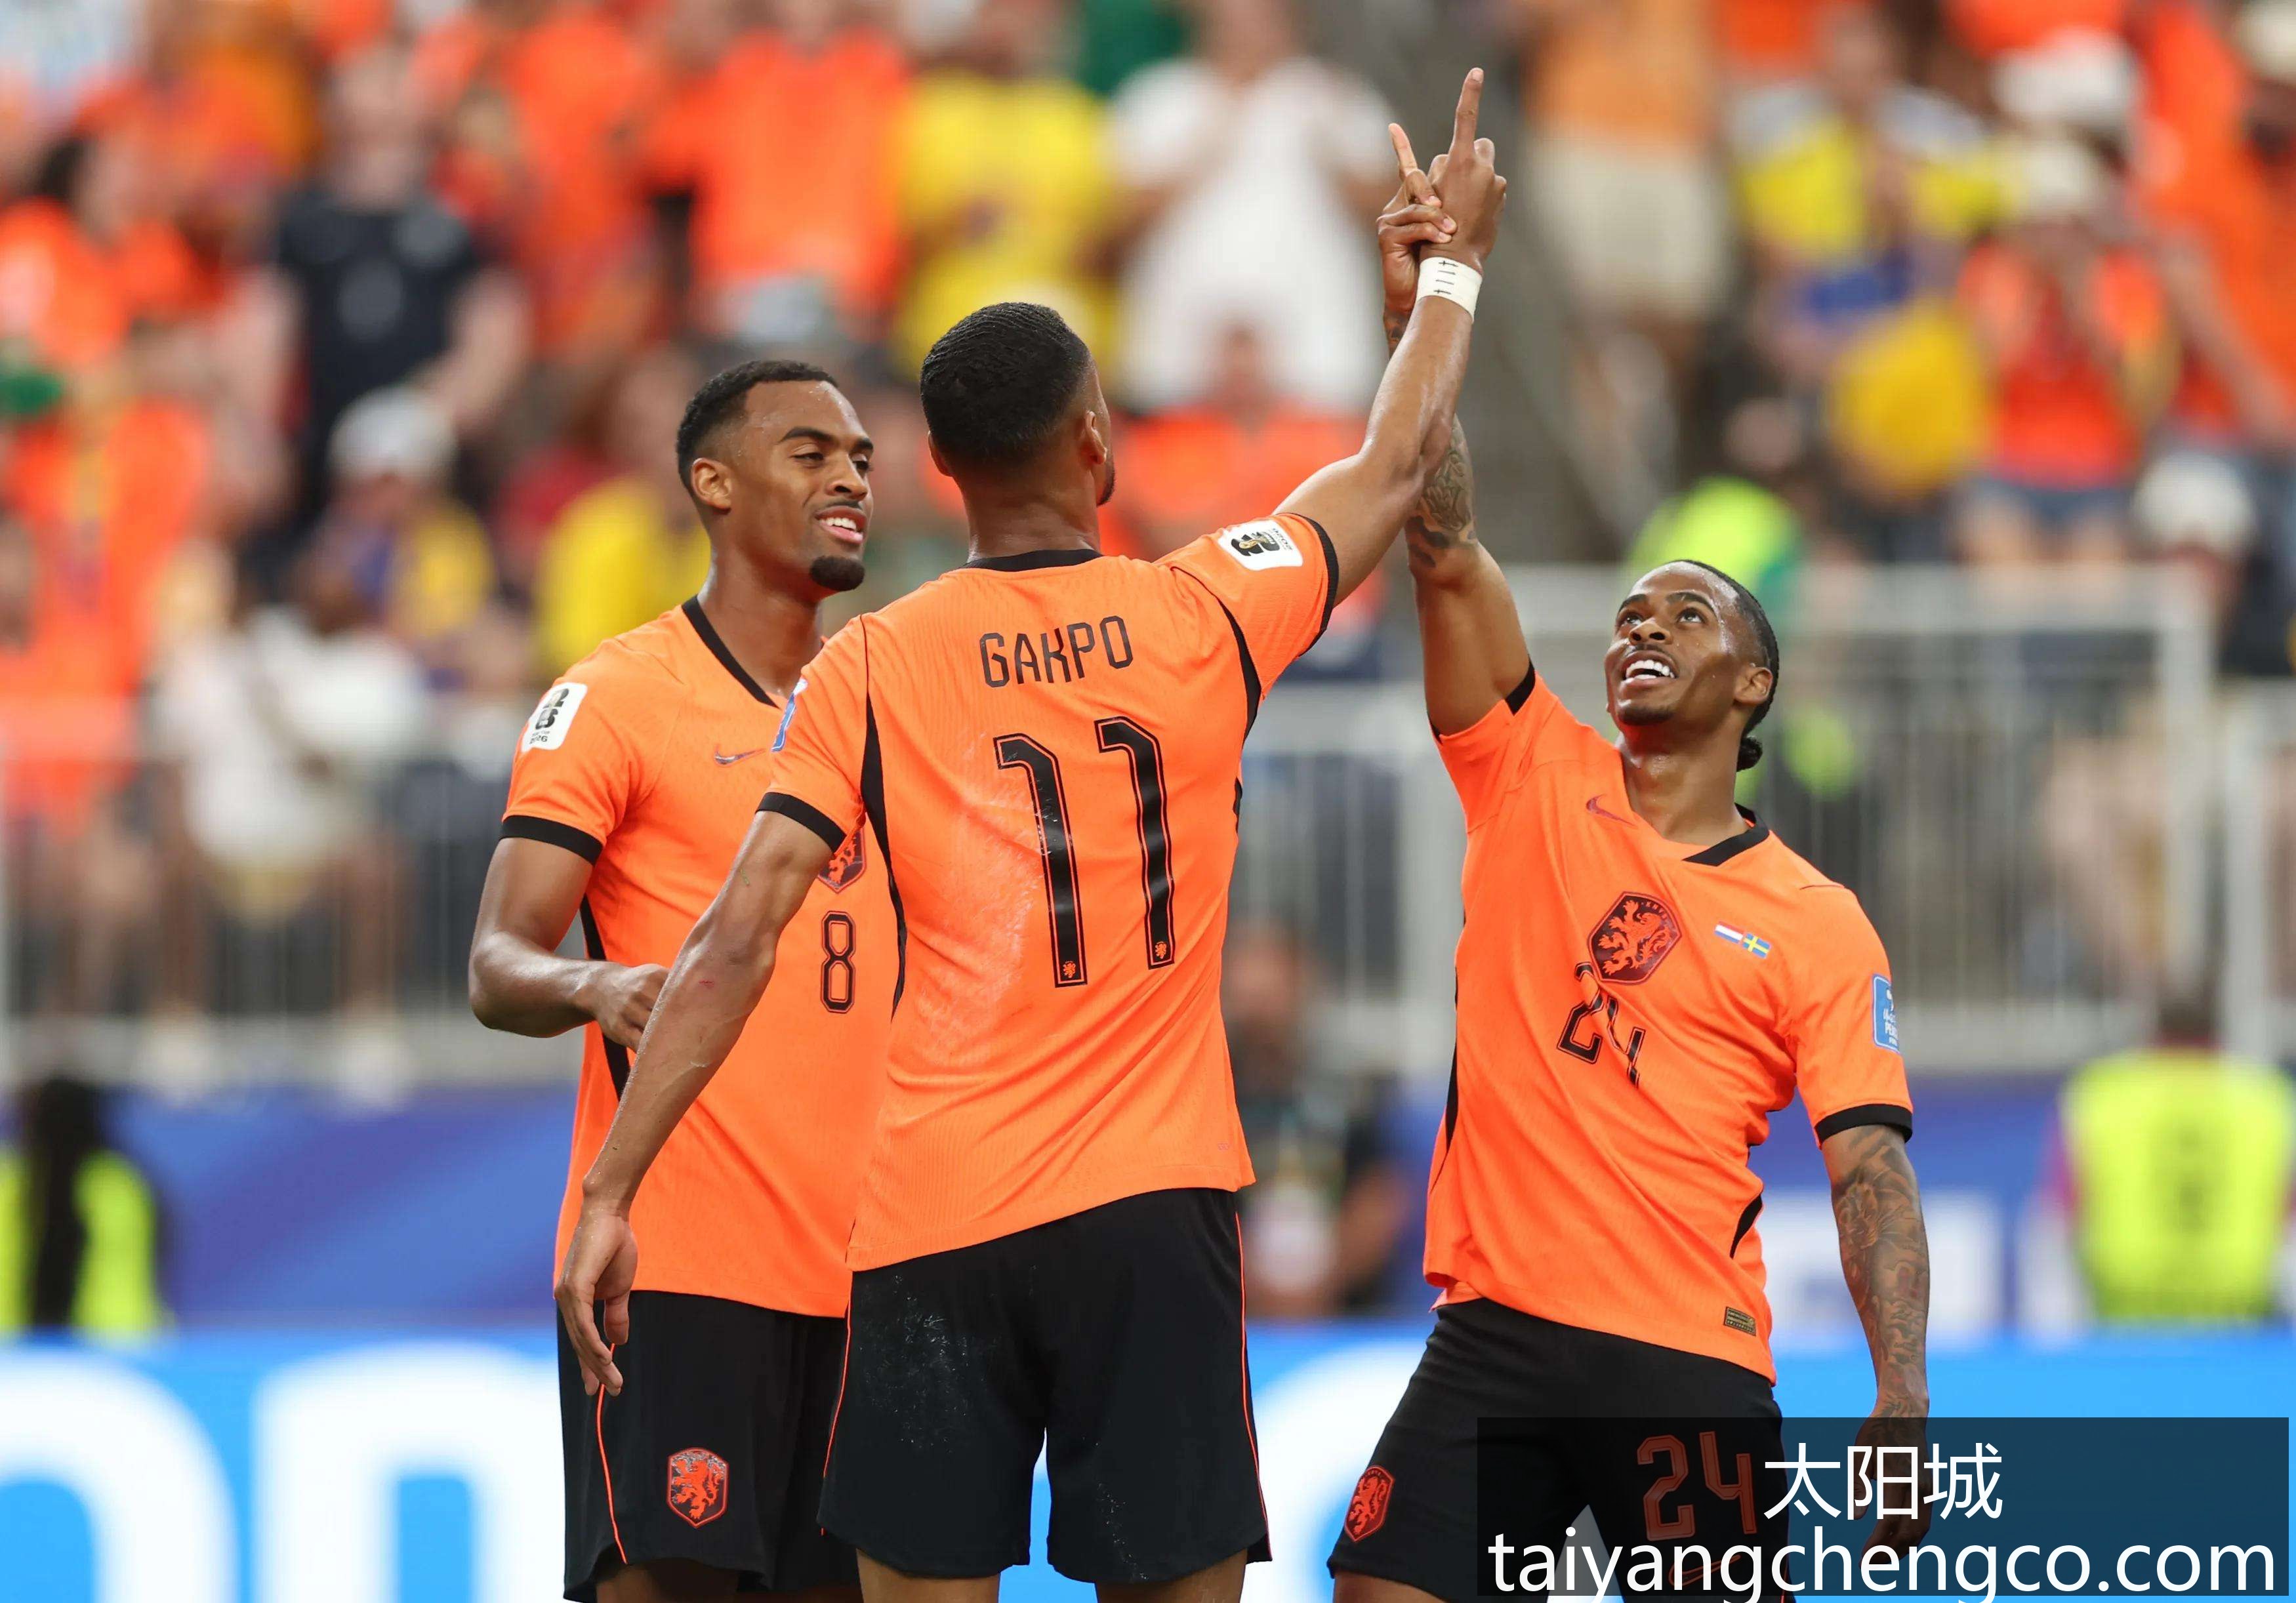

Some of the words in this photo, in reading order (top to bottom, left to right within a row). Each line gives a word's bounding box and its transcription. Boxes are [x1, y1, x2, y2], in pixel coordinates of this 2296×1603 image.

[979, 615, 1134, 687] GAKPO
[993, 716, 1175, 987] 11
[820, 910, 856, 1014] 8
[1557, 962, 1646, 1089] 24
[1637, 1431, 1757, 1541] 24
